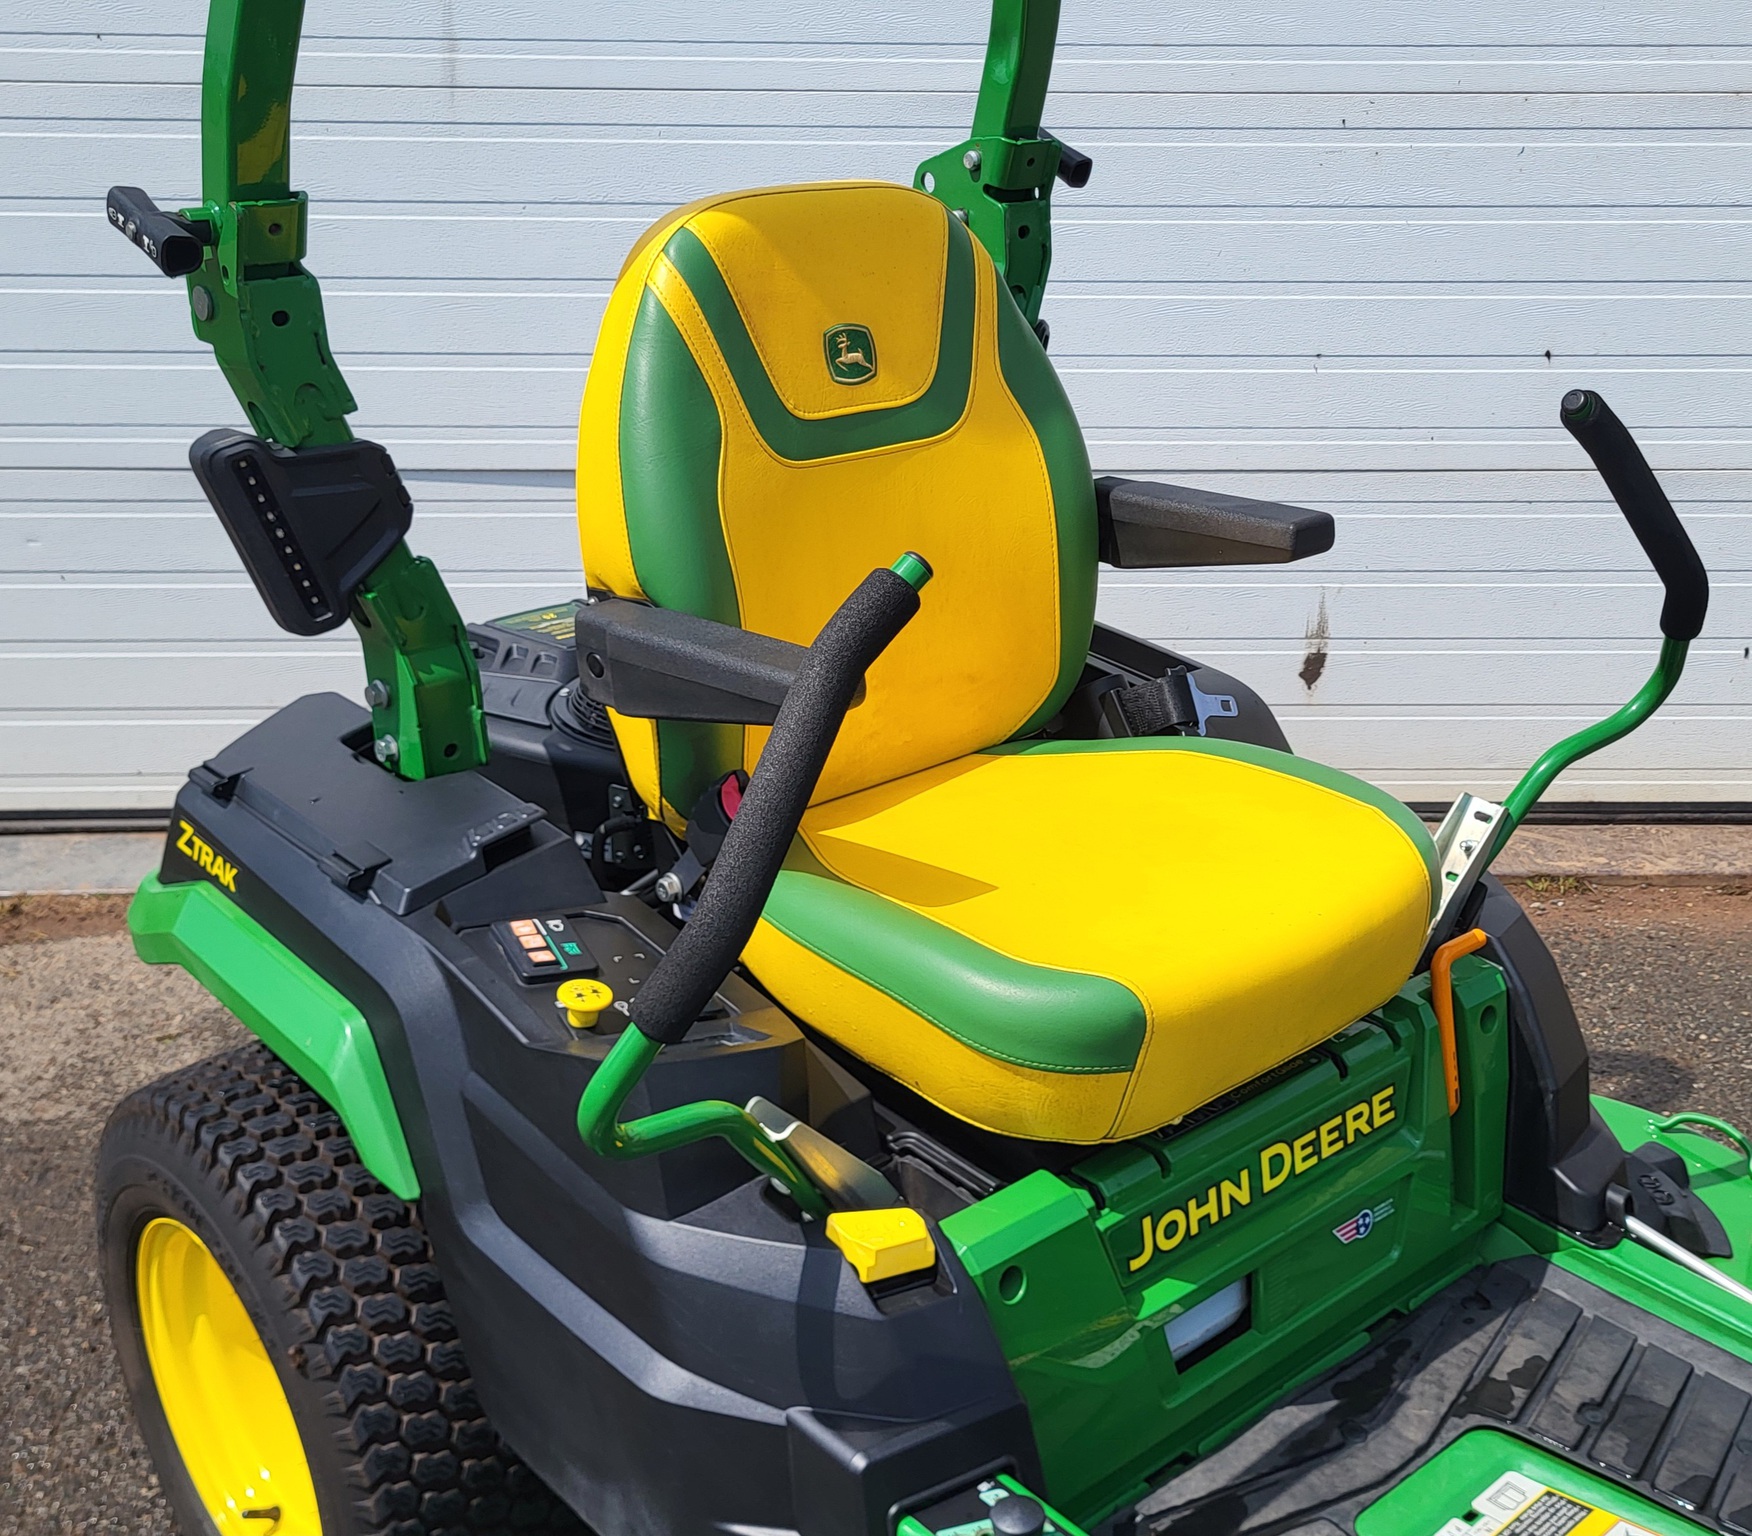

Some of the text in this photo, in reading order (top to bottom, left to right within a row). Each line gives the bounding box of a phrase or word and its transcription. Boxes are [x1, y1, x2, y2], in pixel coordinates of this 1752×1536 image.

[176, 819, 239, 893] ZTRAK
[1129, 1085, 1396, 1272] JOHN DEERE
